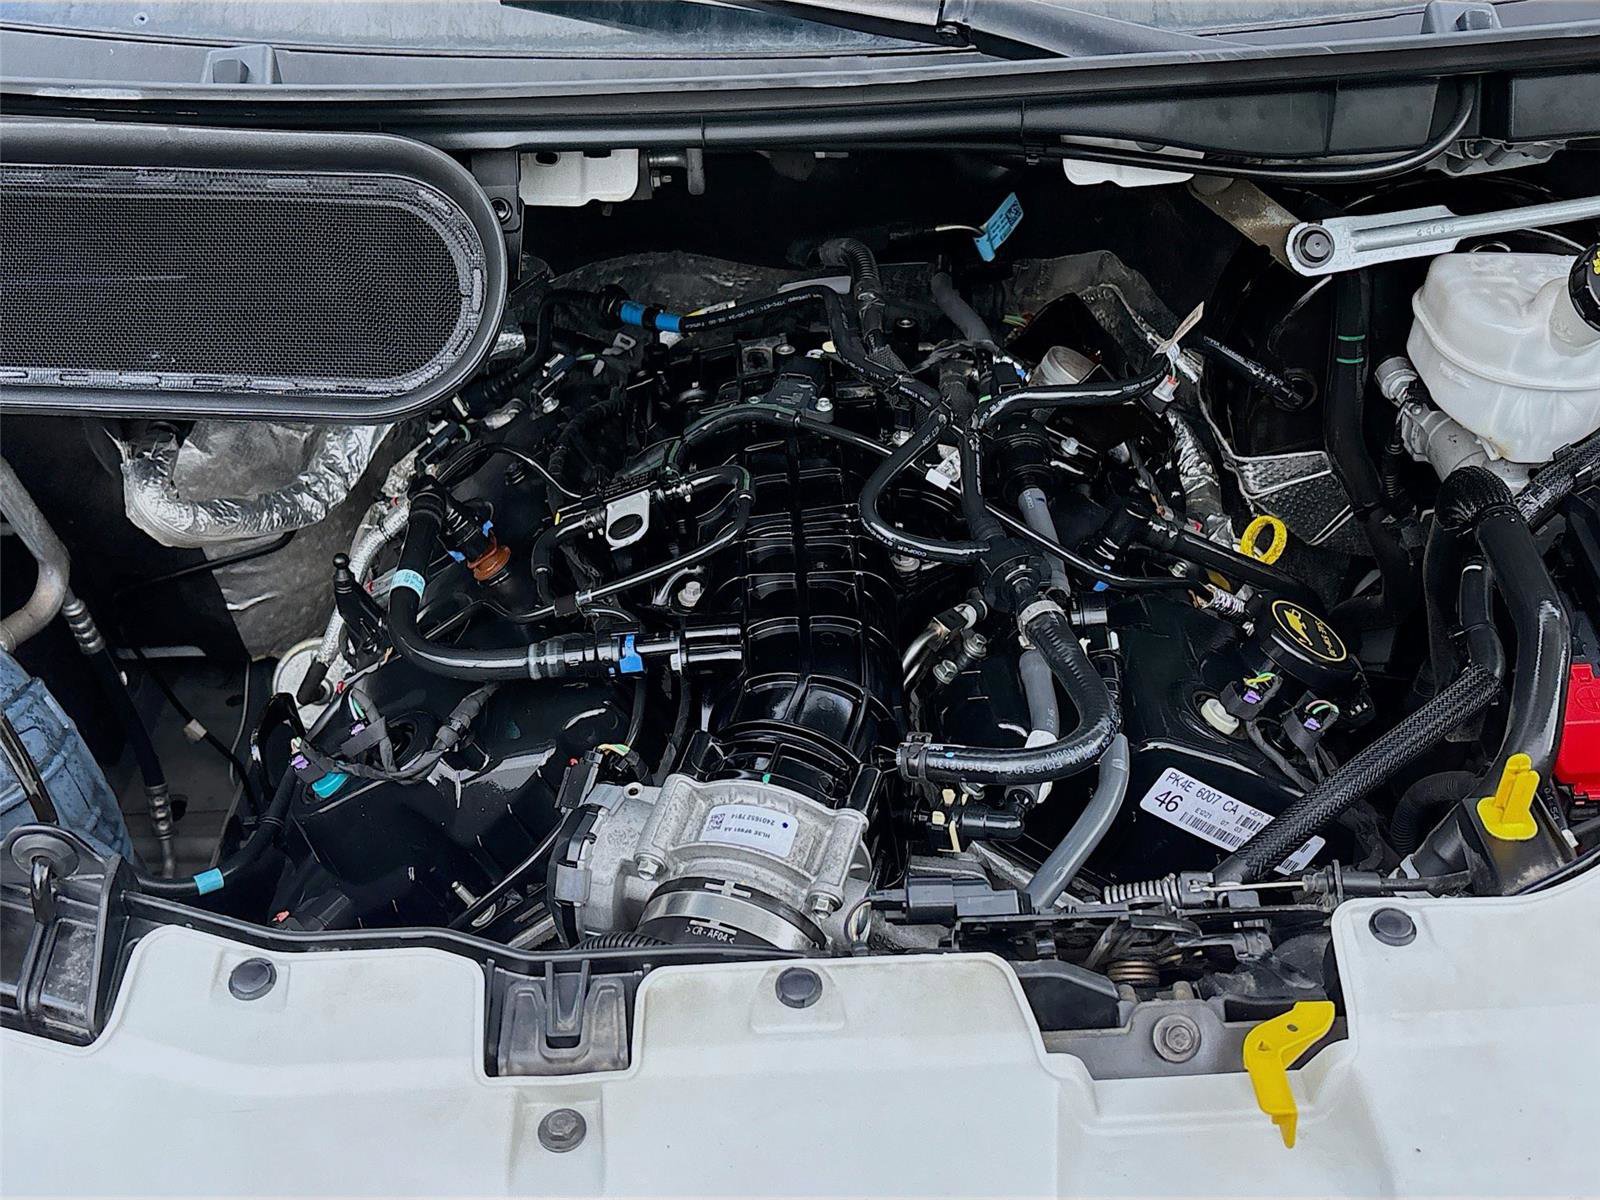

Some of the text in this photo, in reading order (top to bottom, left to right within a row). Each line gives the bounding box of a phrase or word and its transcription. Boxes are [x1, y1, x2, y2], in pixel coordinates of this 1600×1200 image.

[1154, 790, 1184, 813] 46
[1165, 771, 1239, 815] PK4E 6007 CA
